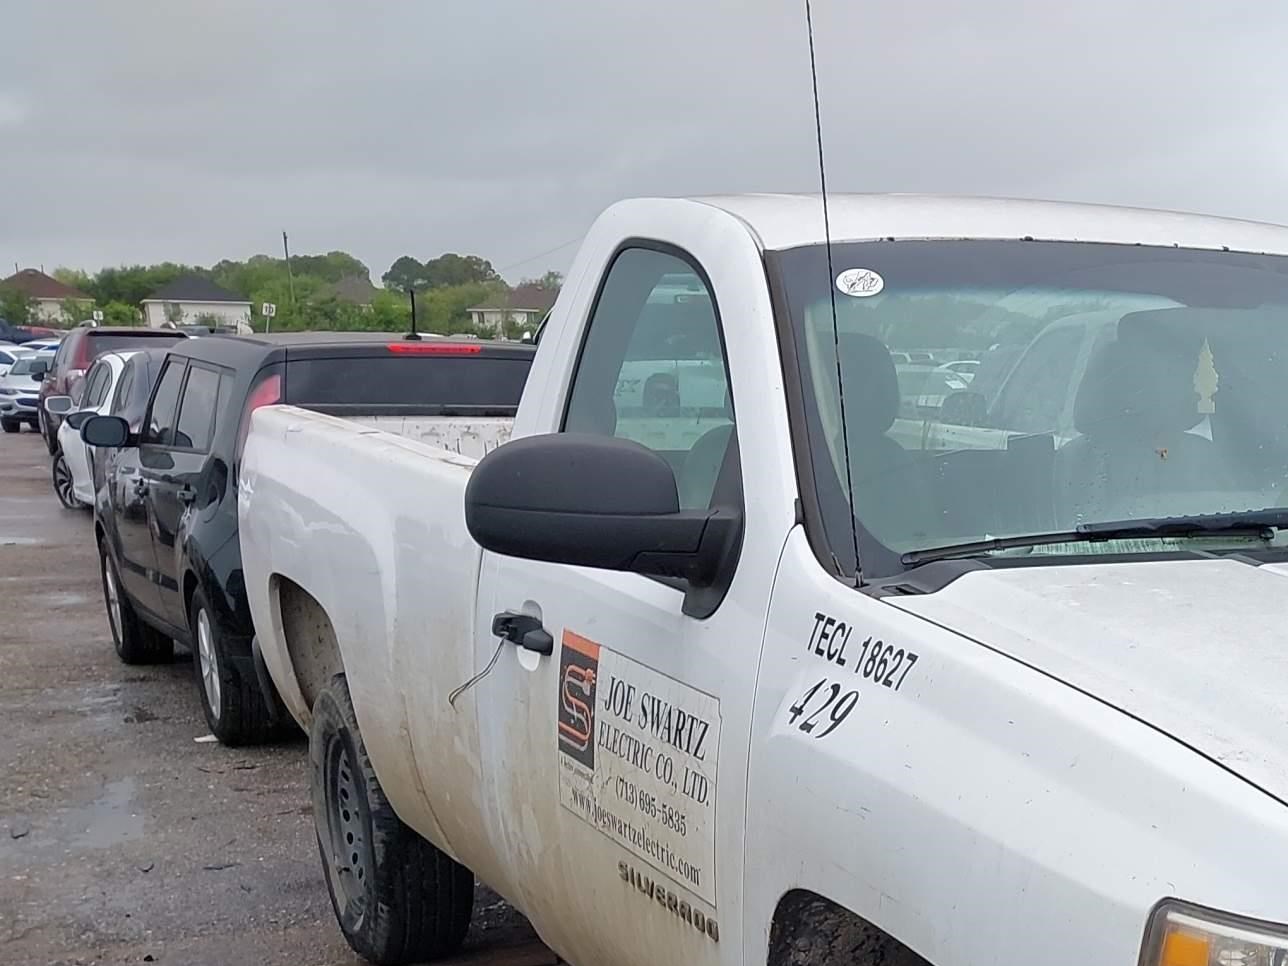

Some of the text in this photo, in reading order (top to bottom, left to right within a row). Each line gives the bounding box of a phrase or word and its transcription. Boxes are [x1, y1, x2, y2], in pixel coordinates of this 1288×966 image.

[807, 612, 919, 691] TECL 18627
[604, 676, 709, 761] JOE SWARTZ
[789, 678, 859, 738] 429
[598, 720, 654, 773] ELECTRIC
[683, 767, 709, 807] LTD.
[571, 786, 701, 886] www.joeswartzelectric.com
[618, 861, 719, 942] SILVERADO
